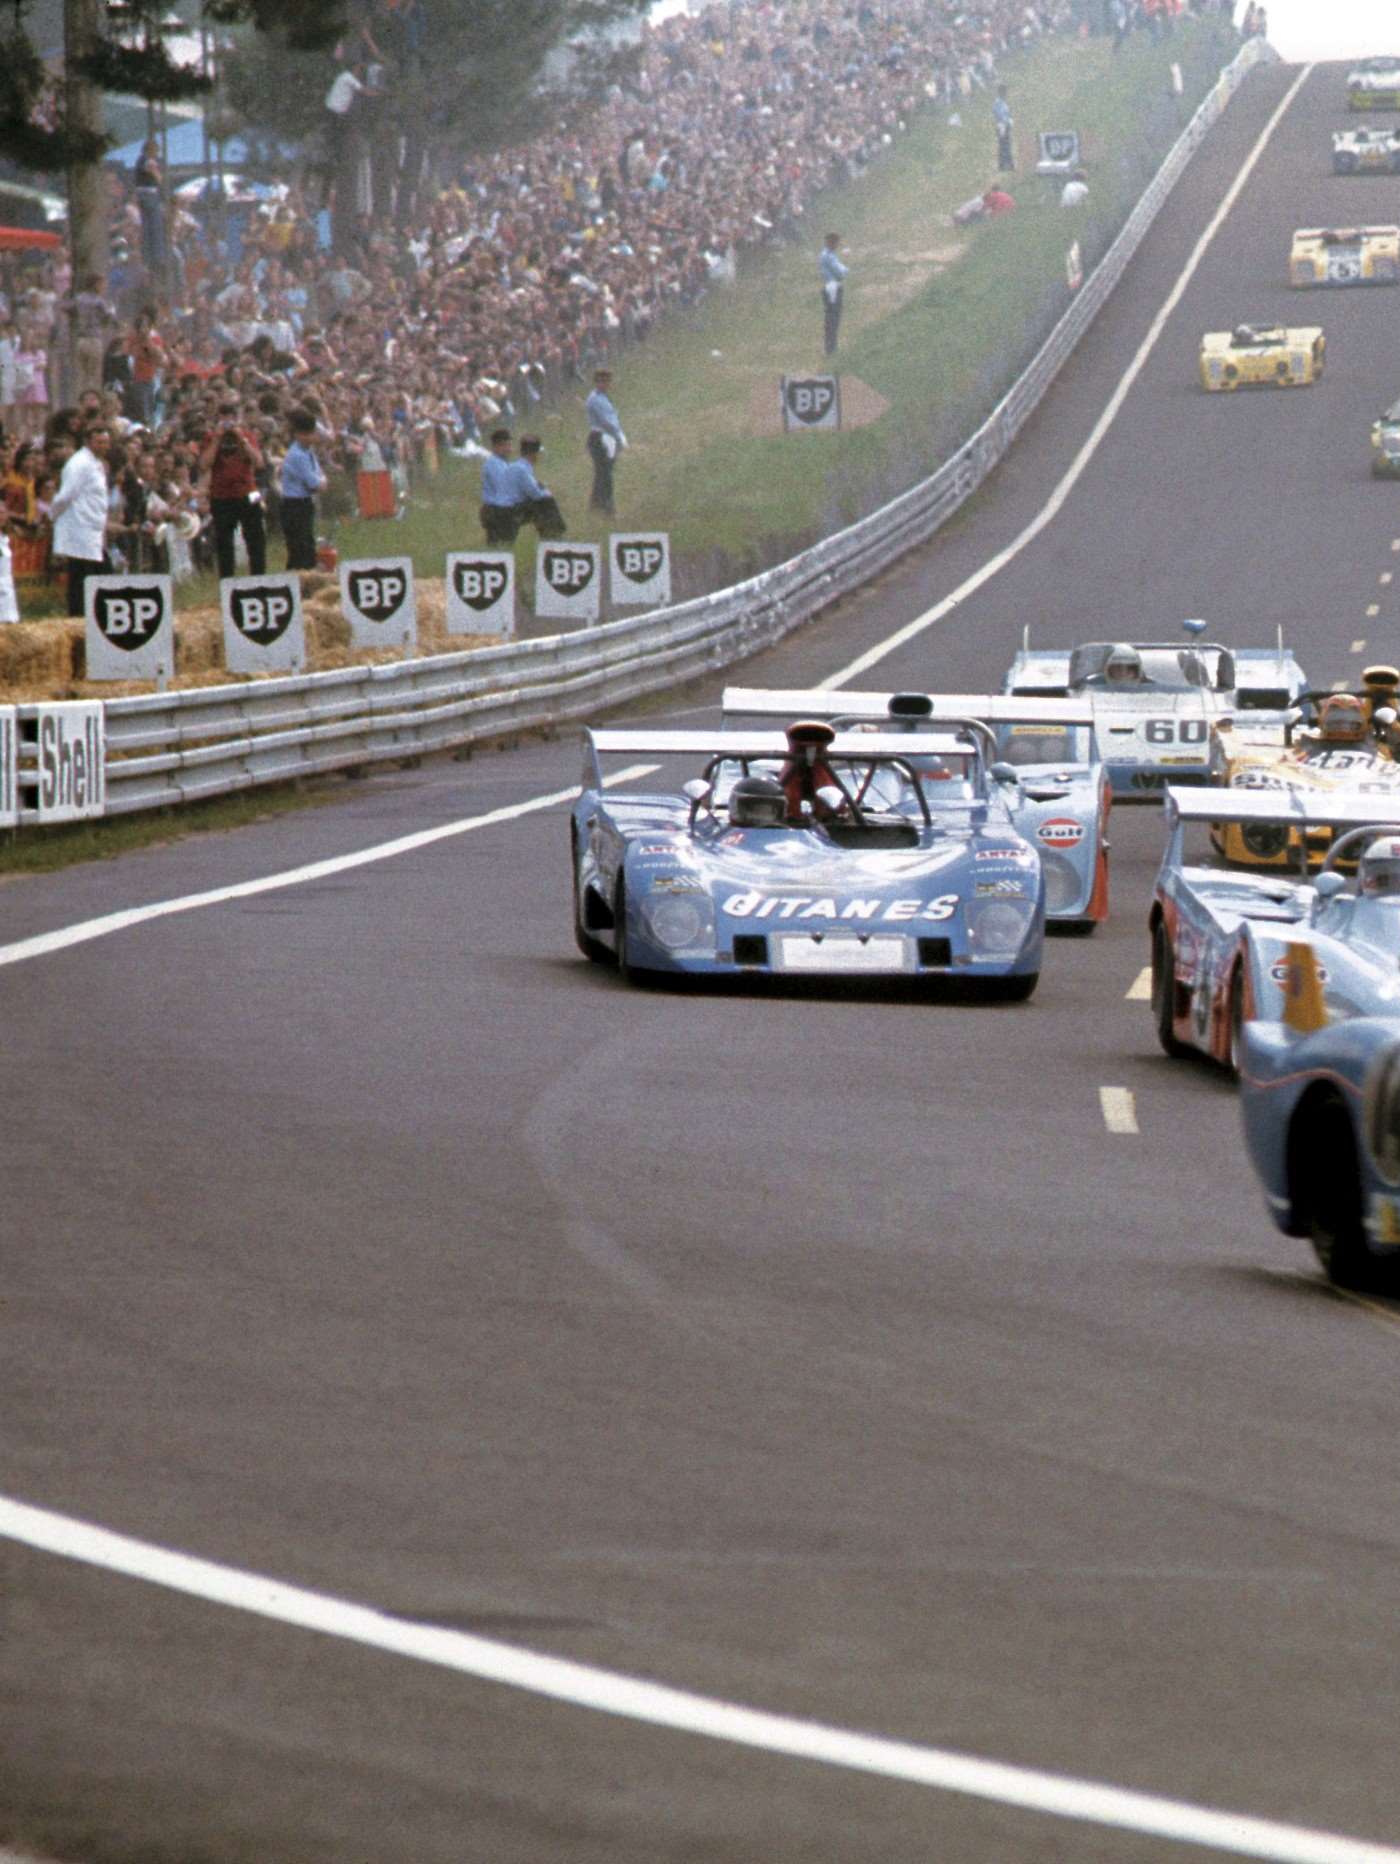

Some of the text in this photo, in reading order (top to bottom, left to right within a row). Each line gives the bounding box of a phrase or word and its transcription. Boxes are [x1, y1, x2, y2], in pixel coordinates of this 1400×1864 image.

[796, 387, 831, 413] BP
[551, 559, 591, 586] BP
[623, 549, 661, 573] BP
[357, 577, 403, 609] BP
[461, 570, 503, 599] BP
[104, 598, 159, 635] BP
[240, 596, 289, 632] BP
[1145, 719, 1207, 744] 60
[42, 715, 100, 809] Shell
[1037, 827, 1083, 838] Gulf
